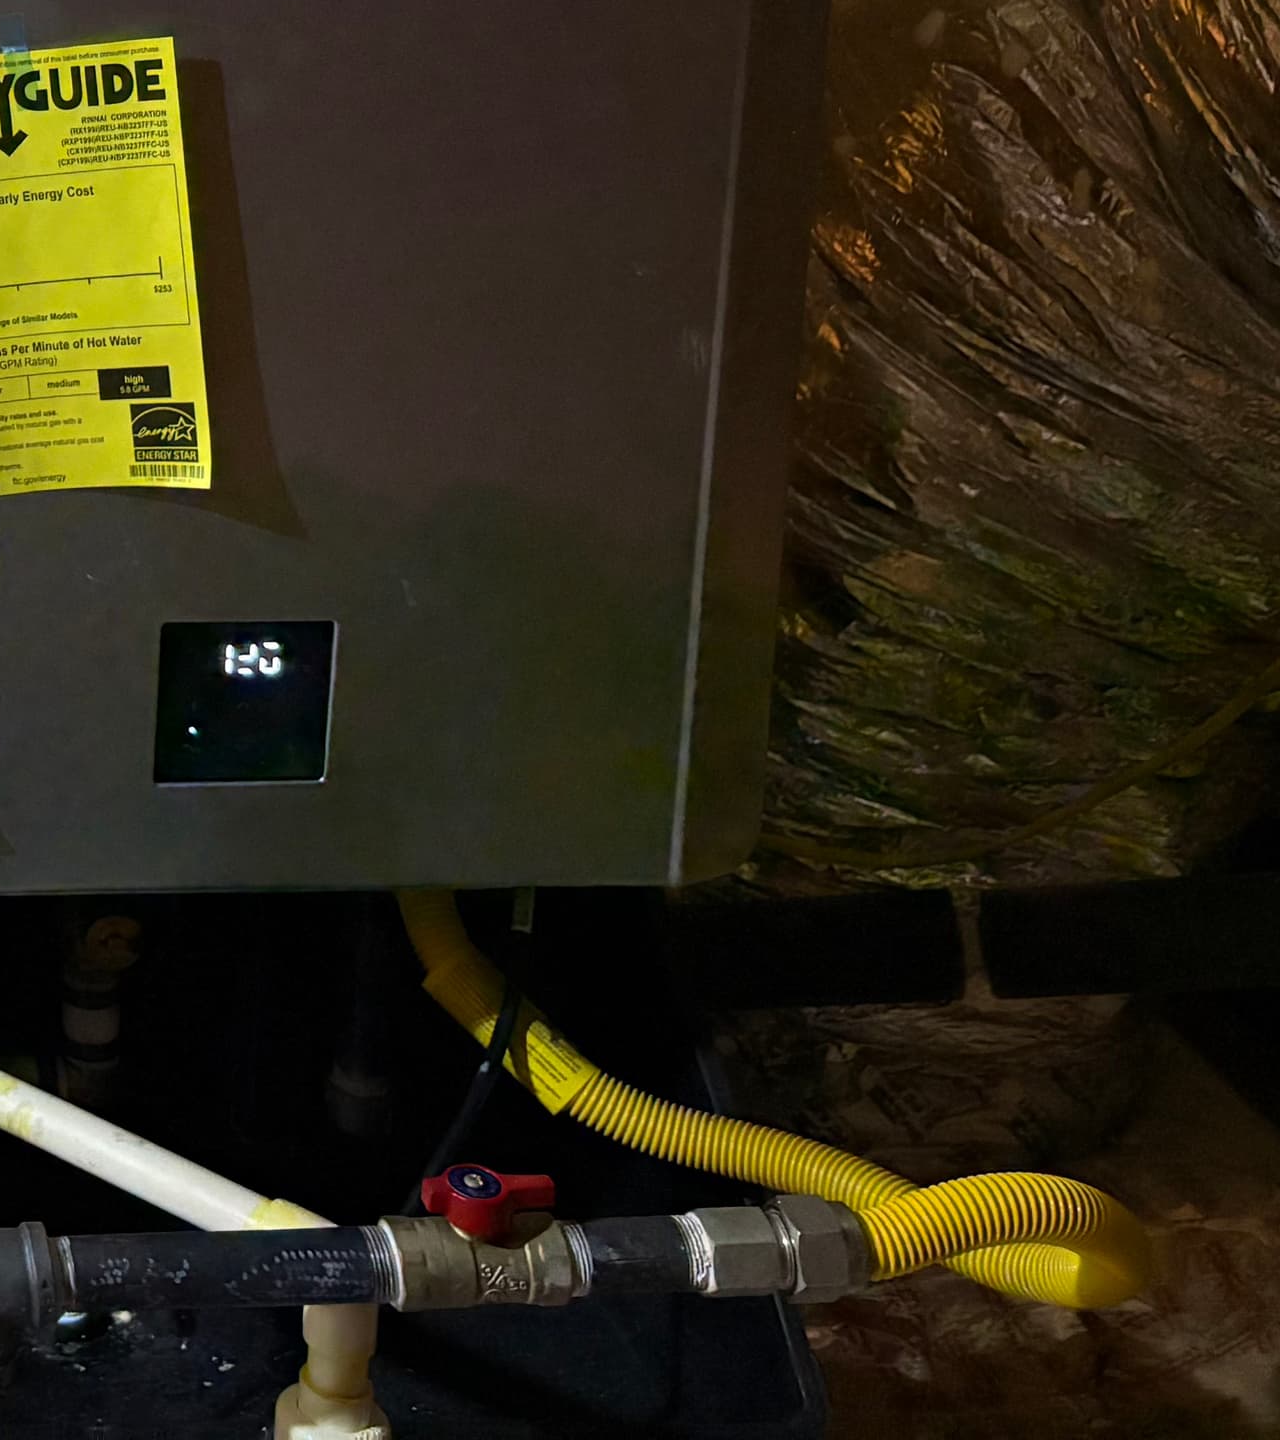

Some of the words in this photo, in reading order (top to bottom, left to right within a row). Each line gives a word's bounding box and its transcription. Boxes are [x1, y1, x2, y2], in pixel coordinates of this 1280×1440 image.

[111, 109, 167, 122] CORPORATION
[23, 187, 65, 205] Energy
[67, 185, 95, 198] Cost
[10, 343, 30, 357] Per
[32, 339, 70, 354] Minute
[73, 337, 84, 349] of
[87, 336, 108, 349] Hot
[110, 335, 142, 348] Water
[24, 356, 58, 371] Rating)
[47, 378, 81, 390] medium
[124, 374, 144, 386] high
[136, 449, 171, 461] ENERGY
[173, 449, 199, 461] STAR
